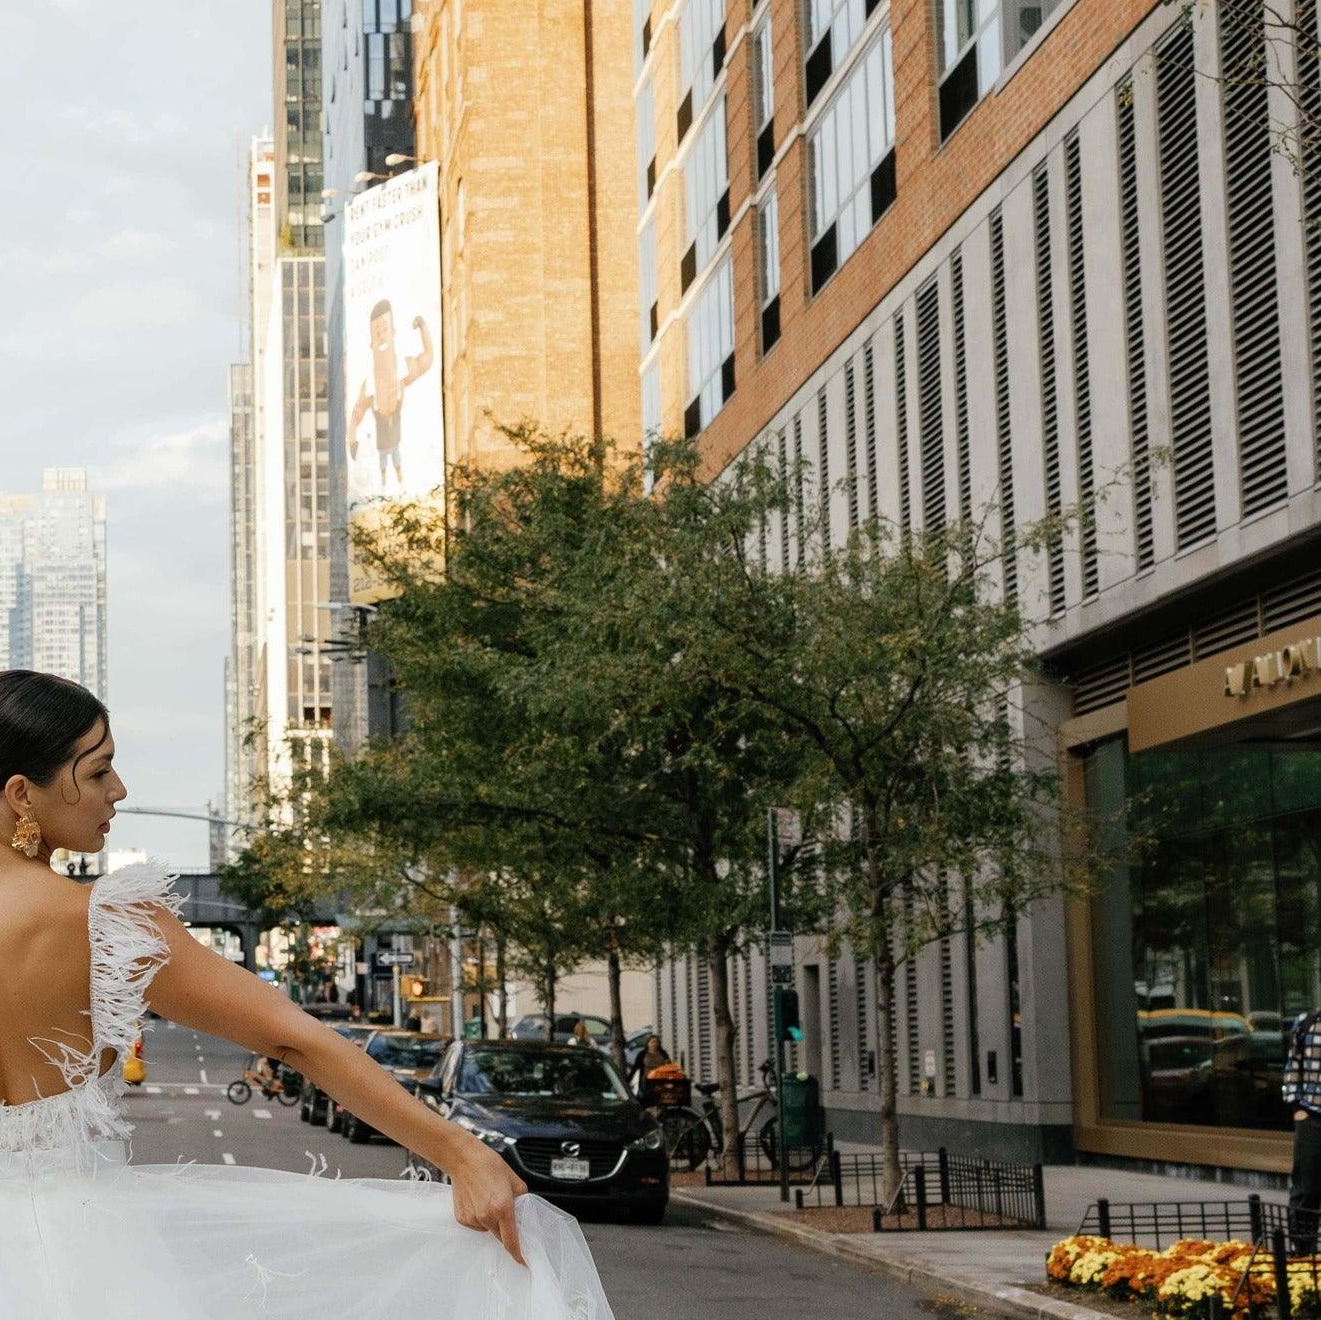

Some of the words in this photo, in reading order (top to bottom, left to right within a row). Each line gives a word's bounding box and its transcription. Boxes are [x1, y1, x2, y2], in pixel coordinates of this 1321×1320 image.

[349, 199, 369, 222] RENT
[372, 185, 402, 209] FASTER
[404, 175, 428, 194] THAN
[350, 225, 370, 247] YOUR
[373, 218, 391, 238] GYM
[394, 205, 423, 229] CRUSH
[350, 255, 366, 275] CAN
